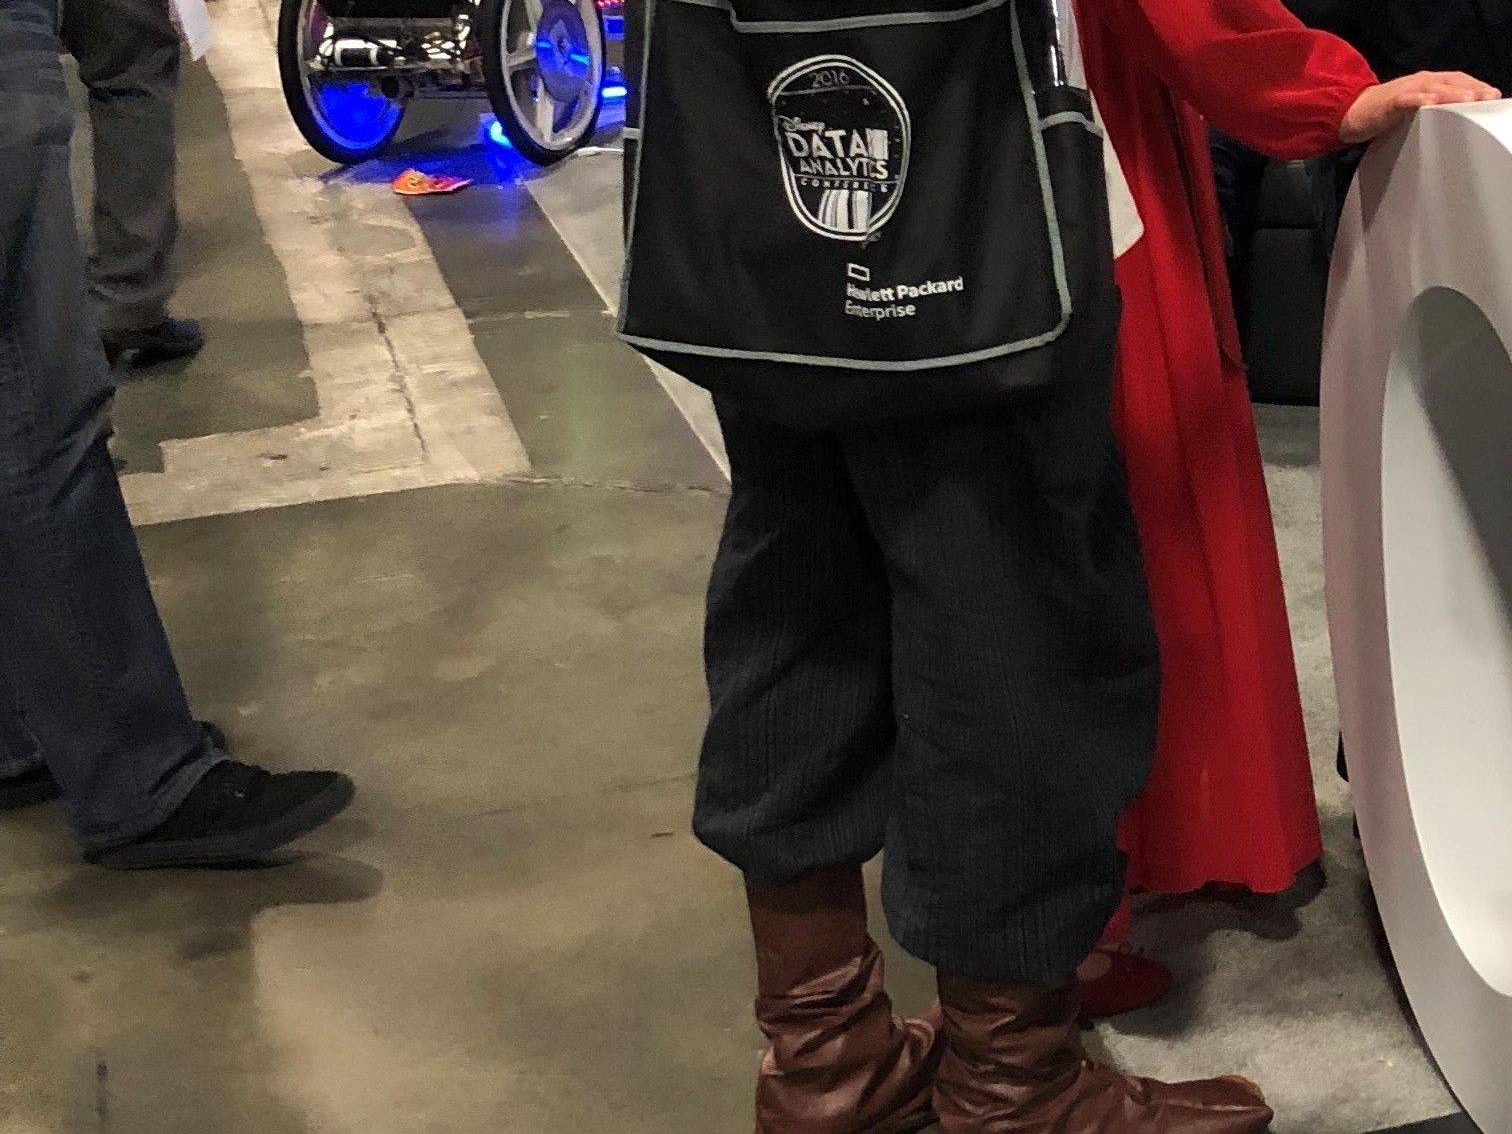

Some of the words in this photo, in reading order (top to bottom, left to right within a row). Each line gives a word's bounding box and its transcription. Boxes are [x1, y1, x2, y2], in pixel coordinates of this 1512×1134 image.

[808, 69, 850, 87] 2016
[784, 128, 869, 158] DATA
[800, 157, 888, 179] ANALYTCS
[897, 276, 964, 300] Packard
